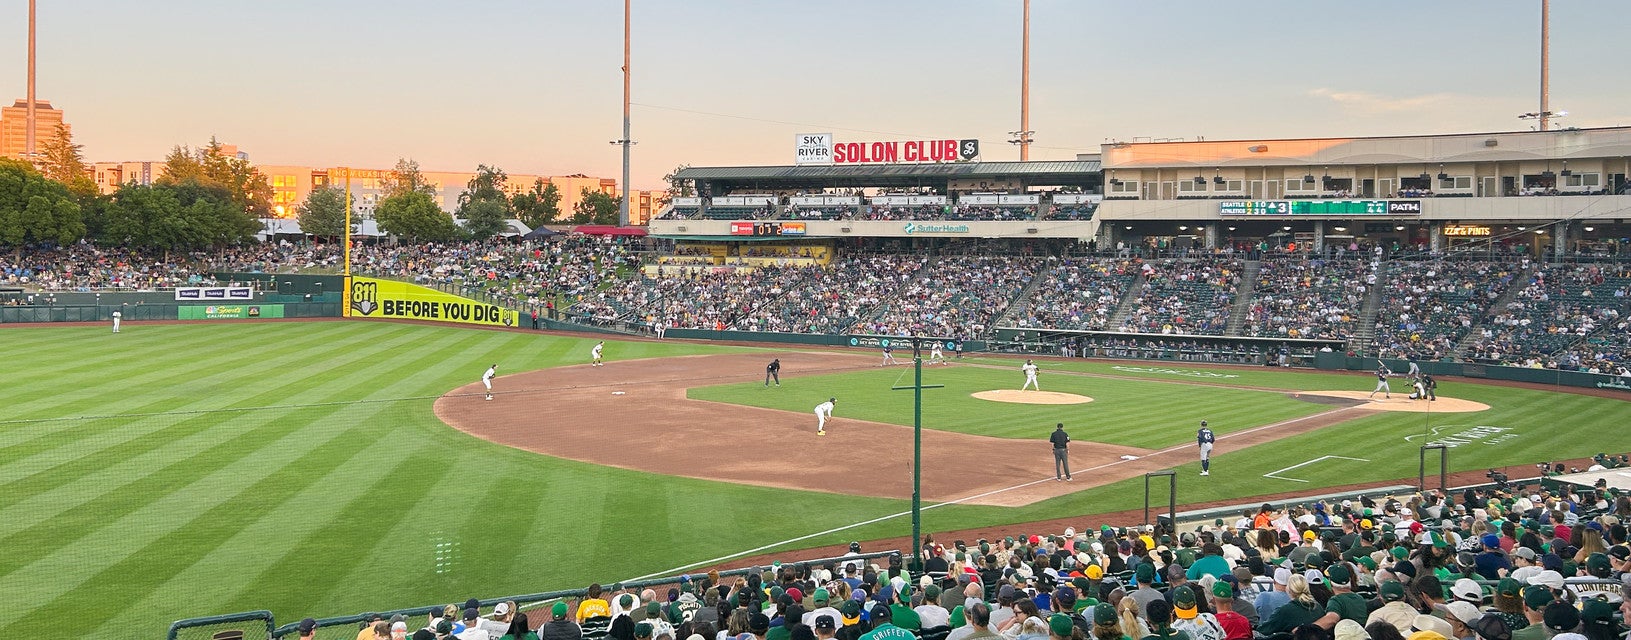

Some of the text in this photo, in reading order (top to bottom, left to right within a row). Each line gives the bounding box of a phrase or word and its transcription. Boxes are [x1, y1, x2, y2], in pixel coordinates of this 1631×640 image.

[803, 136, 824, 145] SKY
[798, 148, 829, 157] RIVER
[834, 139, 958, 163] SOLON CLUB
[1278, 203, 1287, 213] 3
[917, 224, 969, 233] Sutter Health
[1468, 227, 1490, 236] PINTS
[353, 281, 377, 303] 811
[383, 300, 499, 322] BEFORE YOU DIG
[872, 628, 906, 640] GRIFFEY
